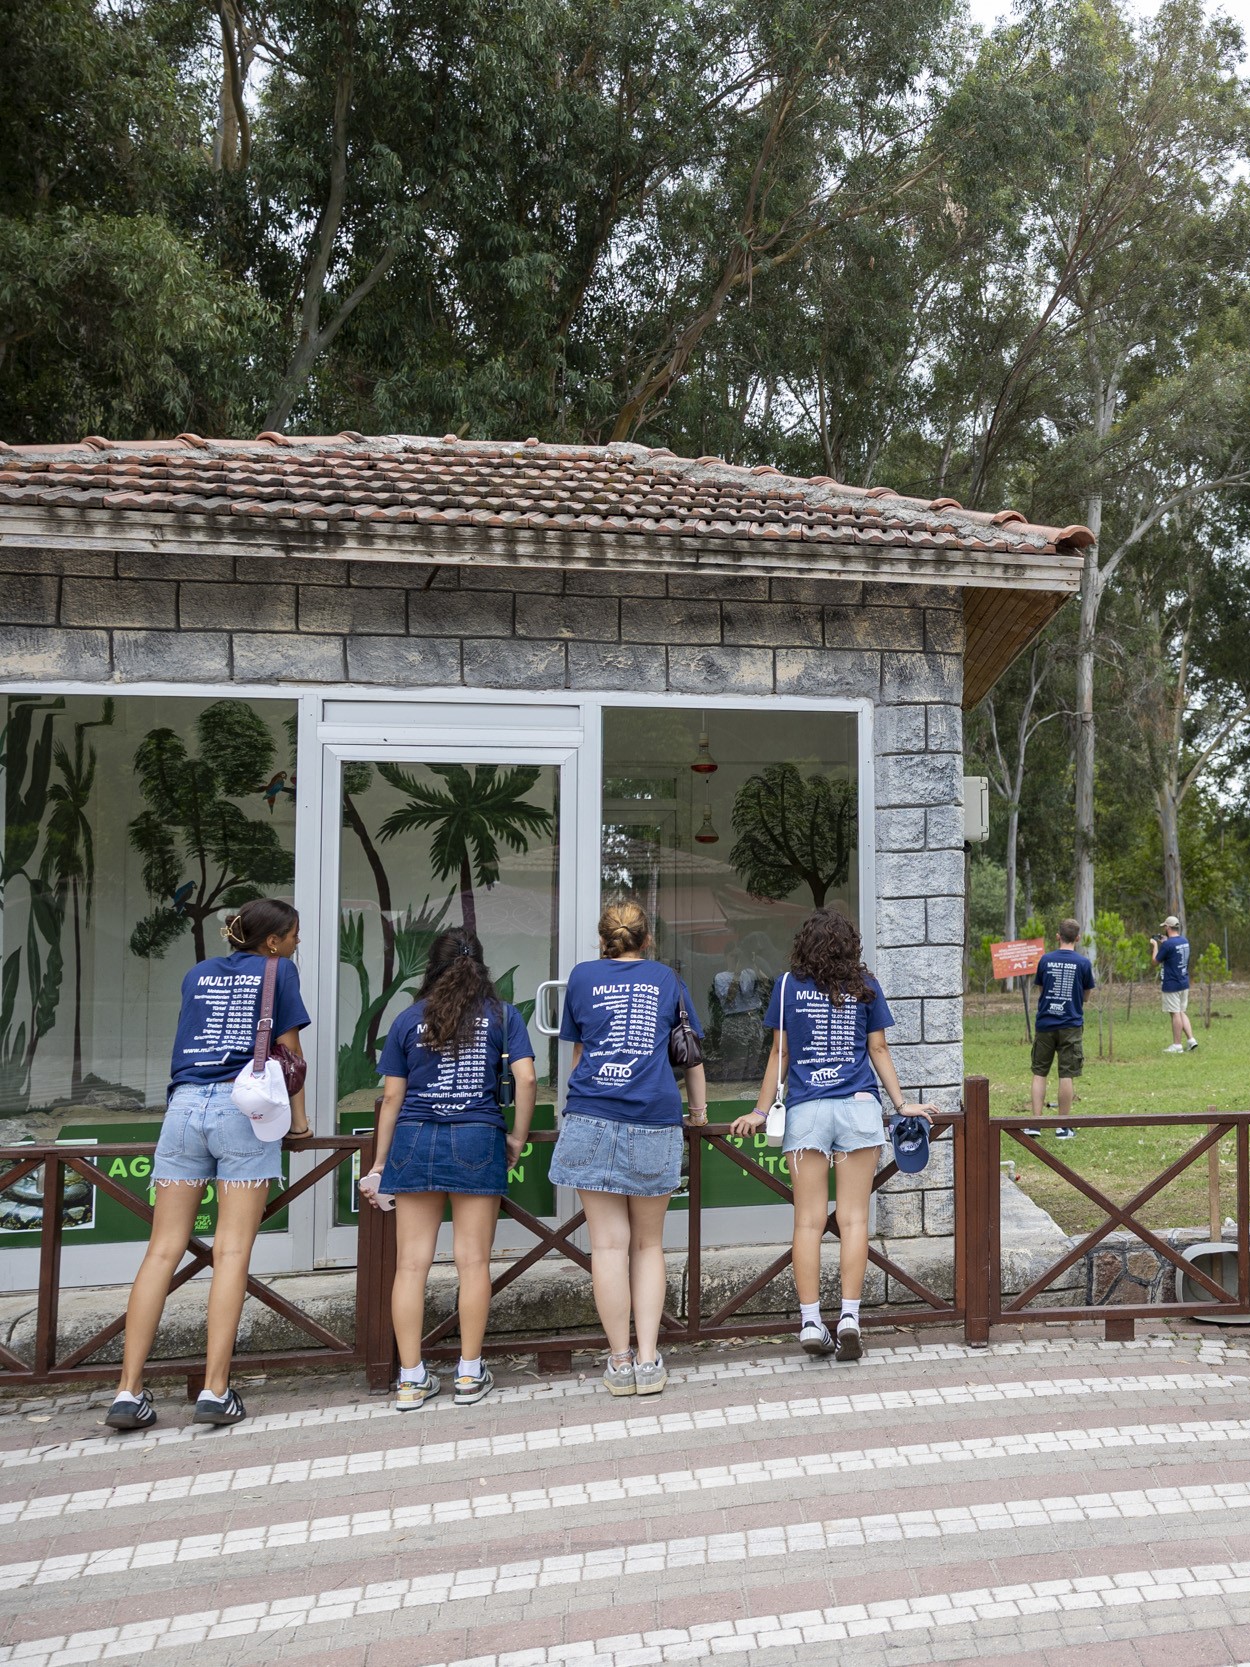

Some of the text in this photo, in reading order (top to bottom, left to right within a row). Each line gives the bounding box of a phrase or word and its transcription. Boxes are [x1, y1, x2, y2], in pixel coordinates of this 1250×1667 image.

[197, 975, 261, 986] MULTI 2025
[593, 984, 659, 996] MULTI 2025
[796, 991, 829, 1001] MULTI
[598, 1063, 632, 1077] ATHO
[811, 1068, 838, 1081] ATHO
